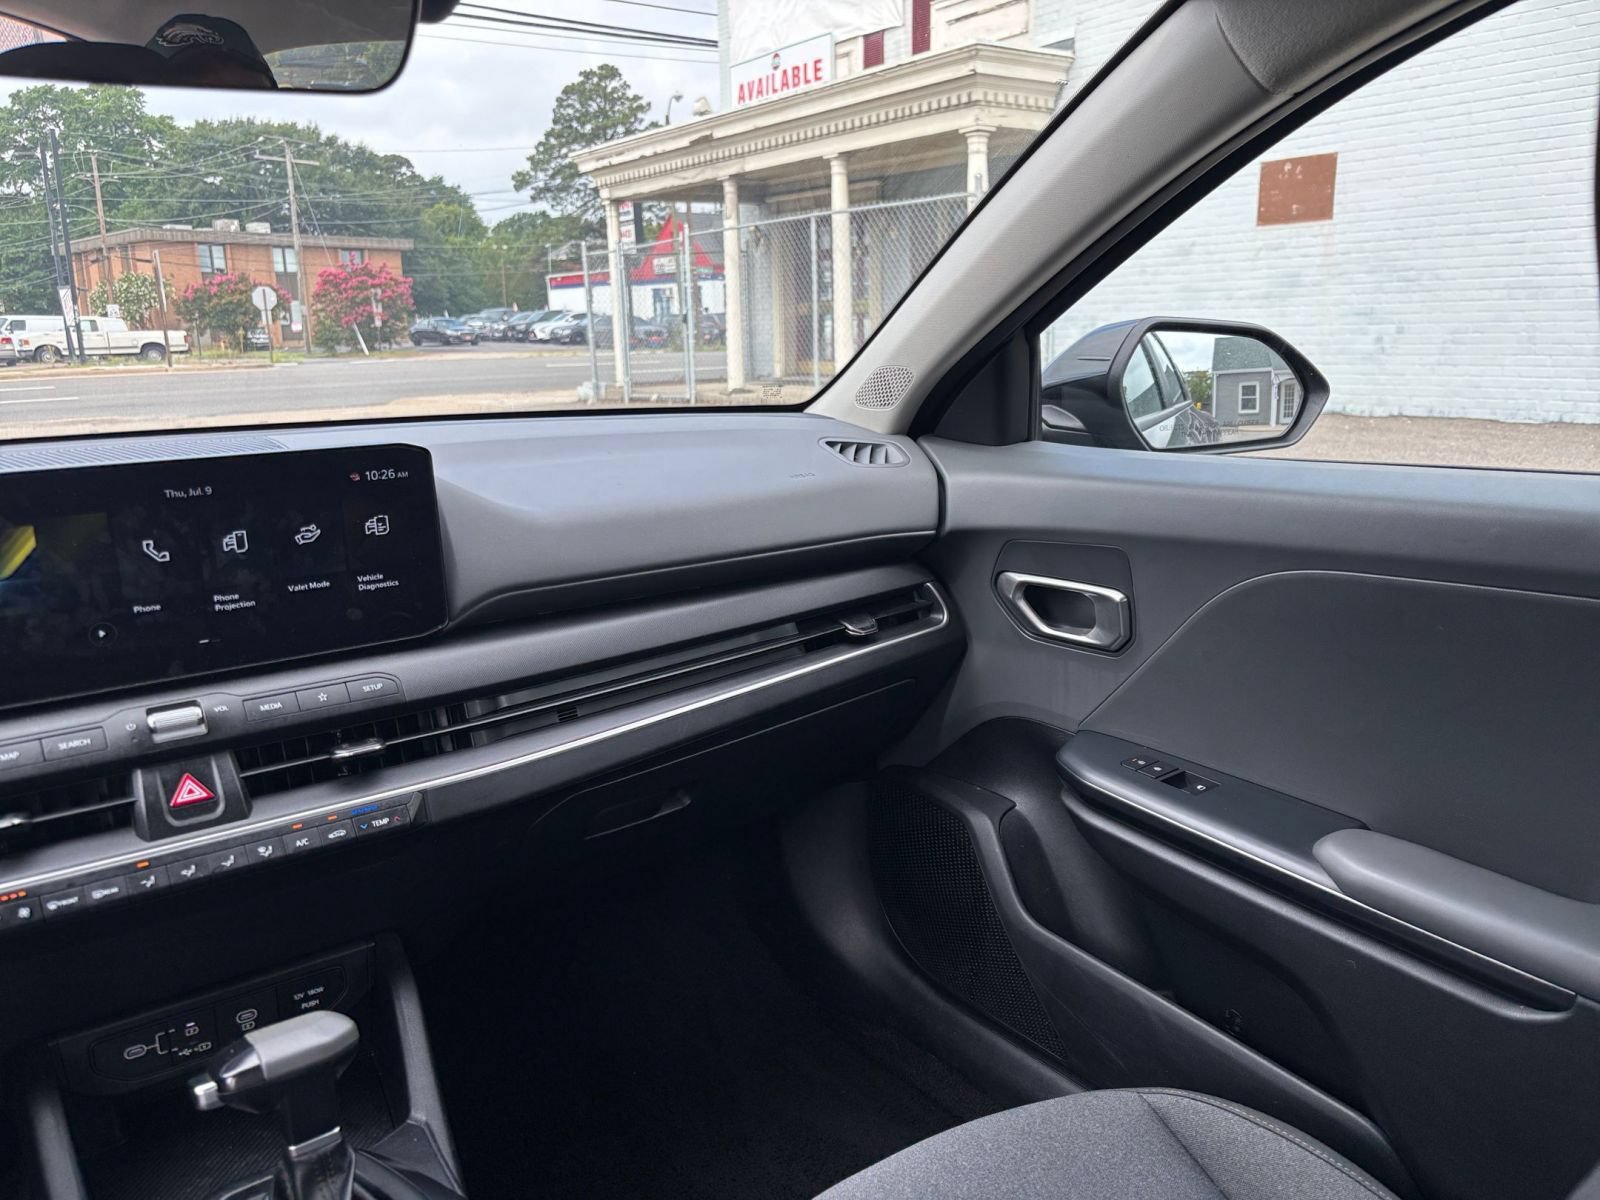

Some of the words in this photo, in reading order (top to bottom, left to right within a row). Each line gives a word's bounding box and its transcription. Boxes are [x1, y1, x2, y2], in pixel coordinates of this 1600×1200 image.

[738, 59, 823, 105] AVAILABLE
[365, 468, 396, 481] 10:26
[163, 489, 188, 499] Thu,
[204, 485, 213, 496] 9
[357, 573, 384, 582] Vehicle
[287, 584, 309, 592] Valet
[308, 580, 331, 589] Mode
[358, 580, 400, 592] Diagnostics
[213, 593, 240, 603] Phone
[133, 604, 162, 614] Phone
[214, 600, 256, 612] Projection
[362, 682, 384, 693] SETUP
[213, 704, 229, 713] VOL
[259, 702, 283, 712] MEDIA
[57, 738, 92, 751] SEARCH
[371, 817, 390, 828] TEMP
[295, 838, 310, 847] A/C
[301, 999, 320, 1010] PUSH
